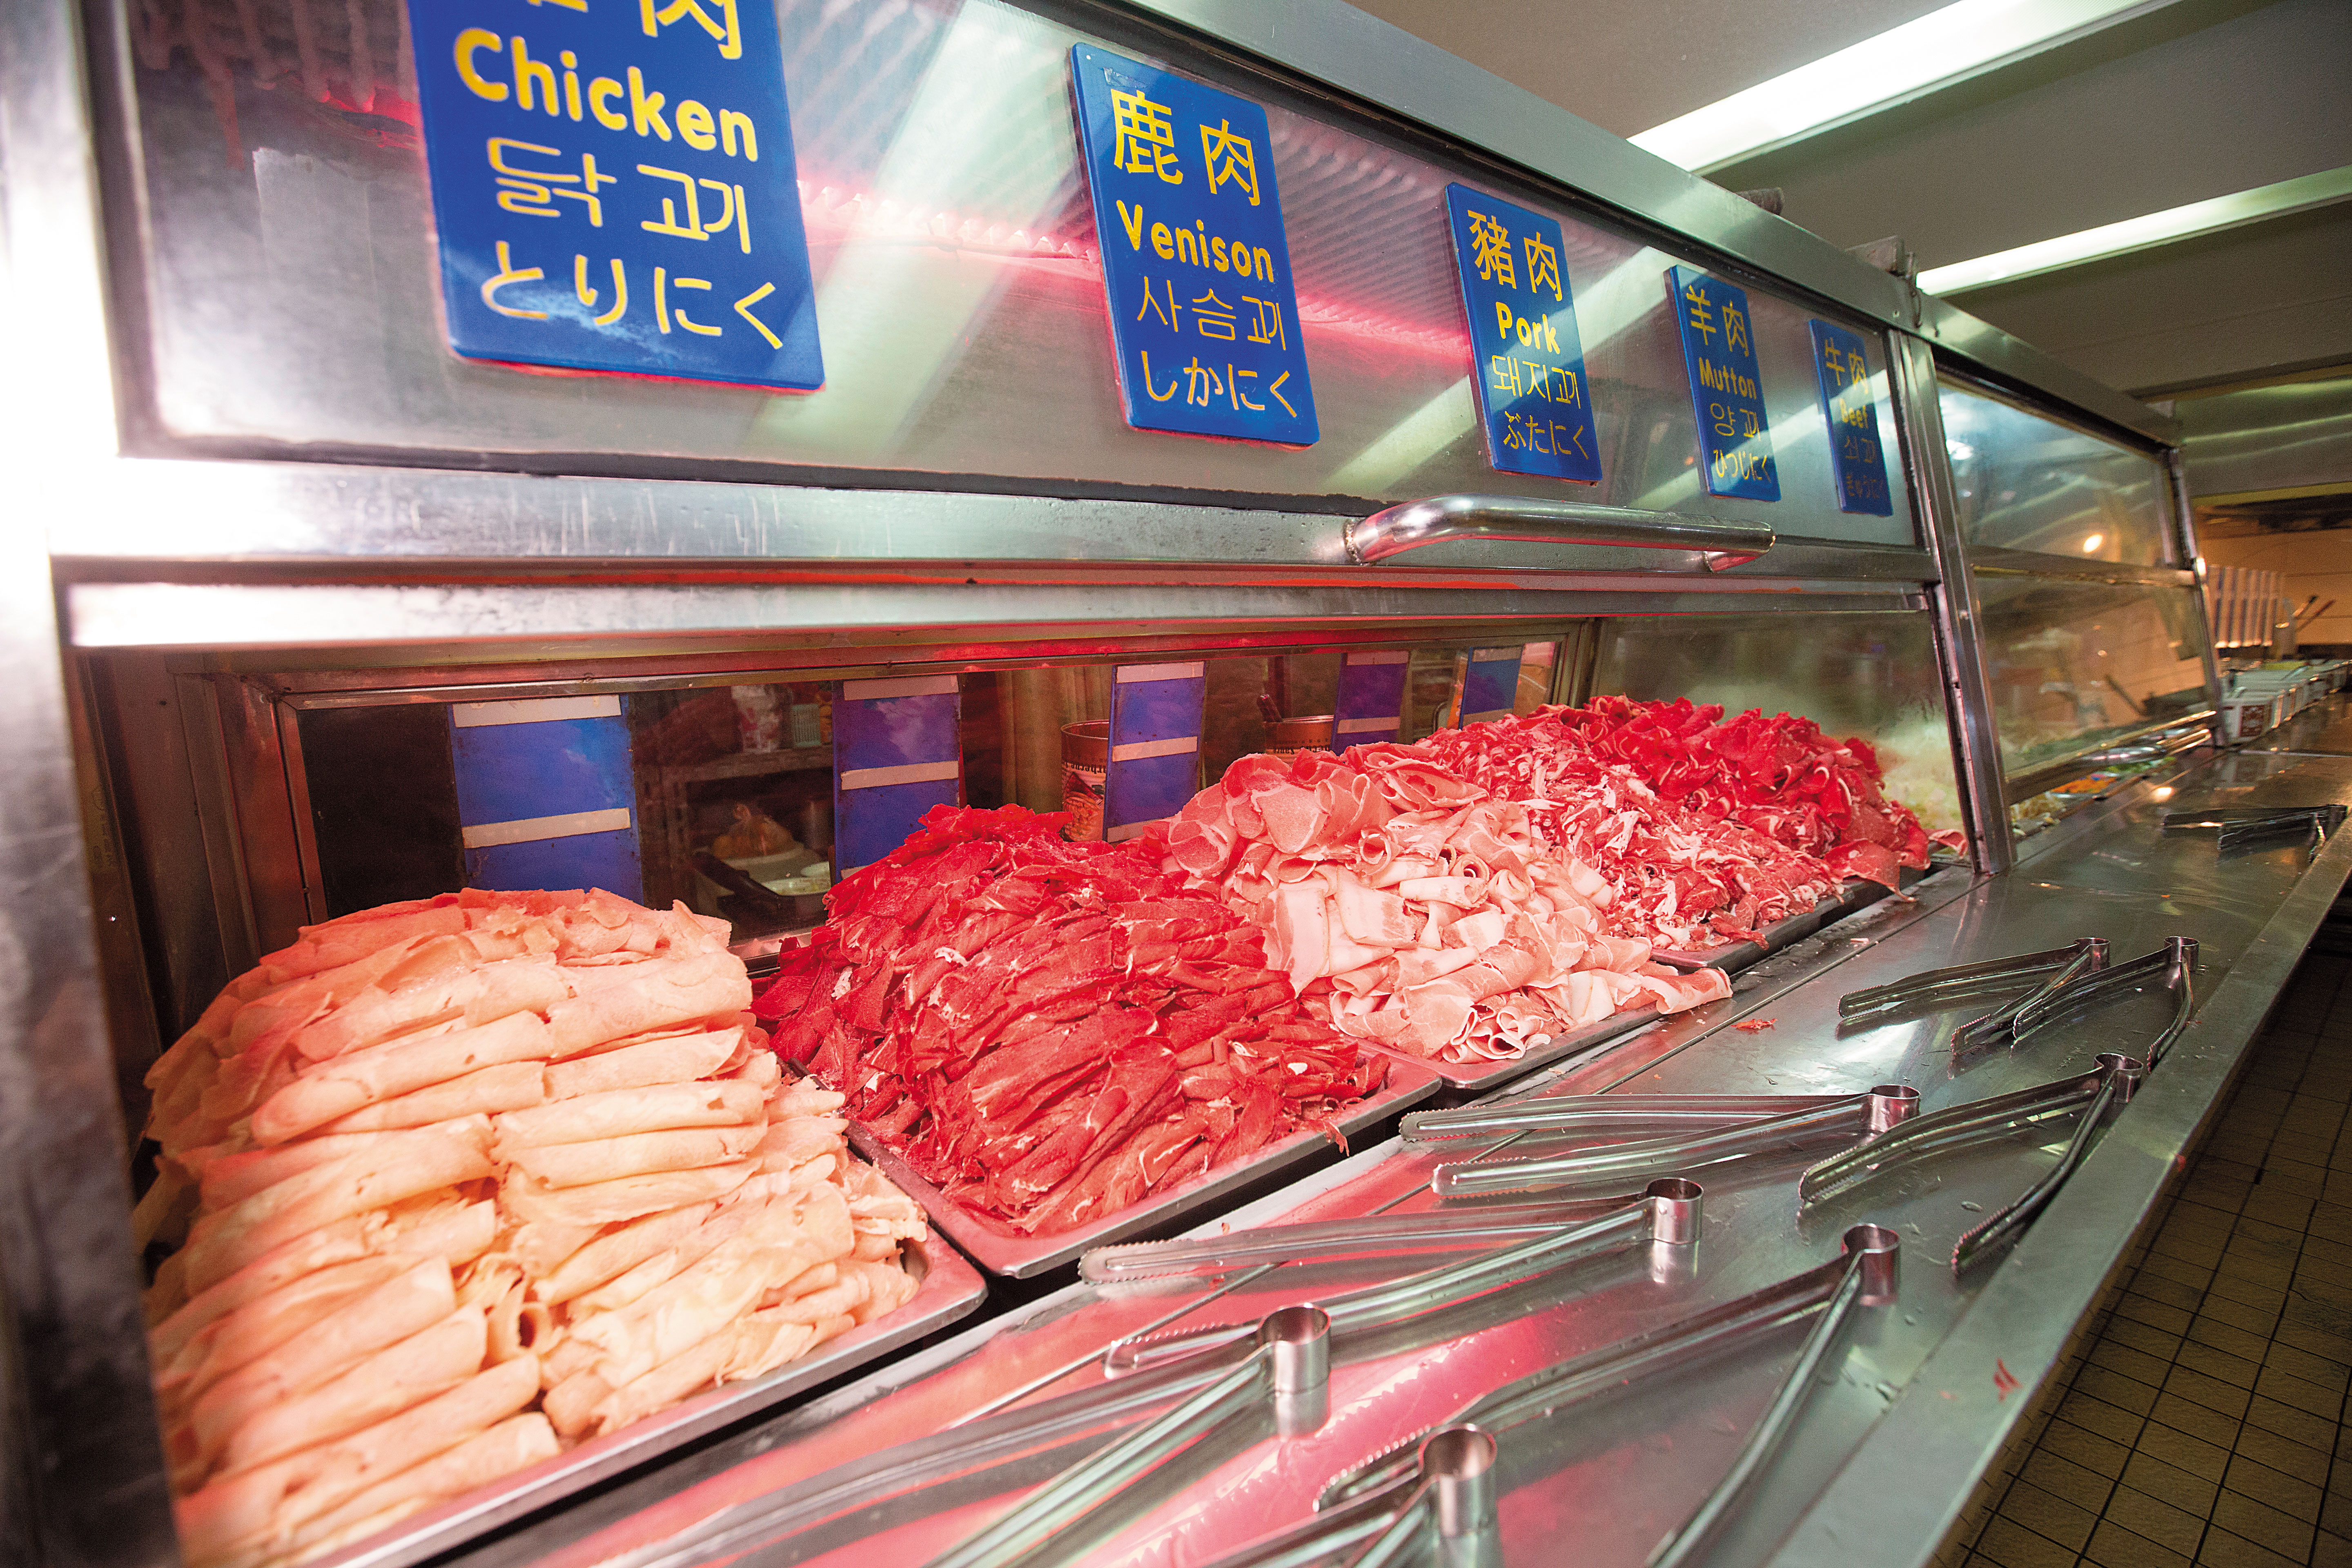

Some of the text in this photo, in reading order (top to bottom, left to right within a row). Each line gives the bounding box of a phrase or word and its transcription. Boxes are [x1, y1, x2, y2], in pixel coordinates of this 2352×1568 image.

[455, 29, 757, 160] Chicken
[1111, 89, 1260, 206] 鹿肉
[1116, 200, 1274, 282] Venison
[1468, 210, 1562, 301] 豬肉
[483, 242, 782, 348] とりにく
[1496, 302, 1560, 354] Pork
[1686, 285, 1748, 356] 羊肉
[1141, 351, 1296, 417] しかにく
[1699, 357, 1756, 399] Mutton
[1503, 411, 1588, 459] ぶたにく
[1839, 399, 1868, 428] Beef
[1713, 450, 1771, 483] ひつじにく
